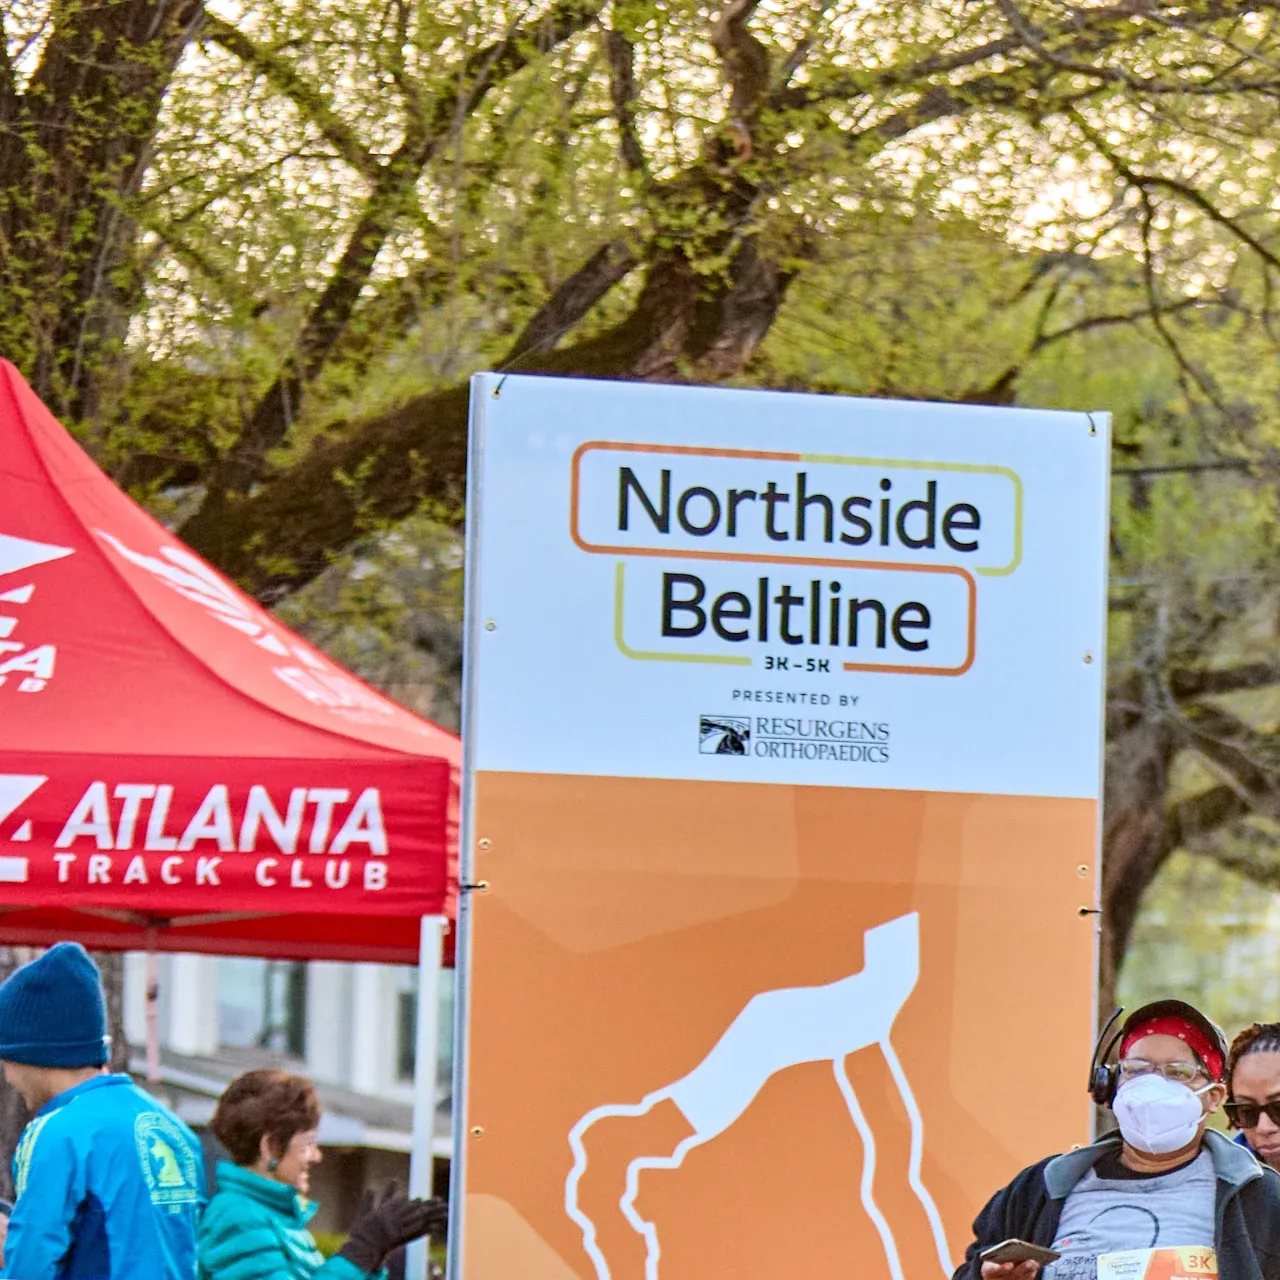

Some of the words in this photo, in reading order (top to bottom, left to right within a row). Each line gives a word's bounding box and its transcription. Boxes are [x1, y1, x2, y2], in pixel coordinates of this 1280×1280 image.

[617, 465, 982, 554] Northside
[660, 571, 932, 653] Beltline
[731, 689, 832, 706] PRESENTED
[839, 695, 860, 707] BY
[755, 717, 890, 741] RESURGENS
[754, 740, 890, 764] ORTHOPAEDICS
[53, 780, 390, 856] ATLANTA
[53, 853, 223, 886] TRACK
[255, 857, 390, 891] CLUB
[1187, 1254, 1212, 1270] 3K
